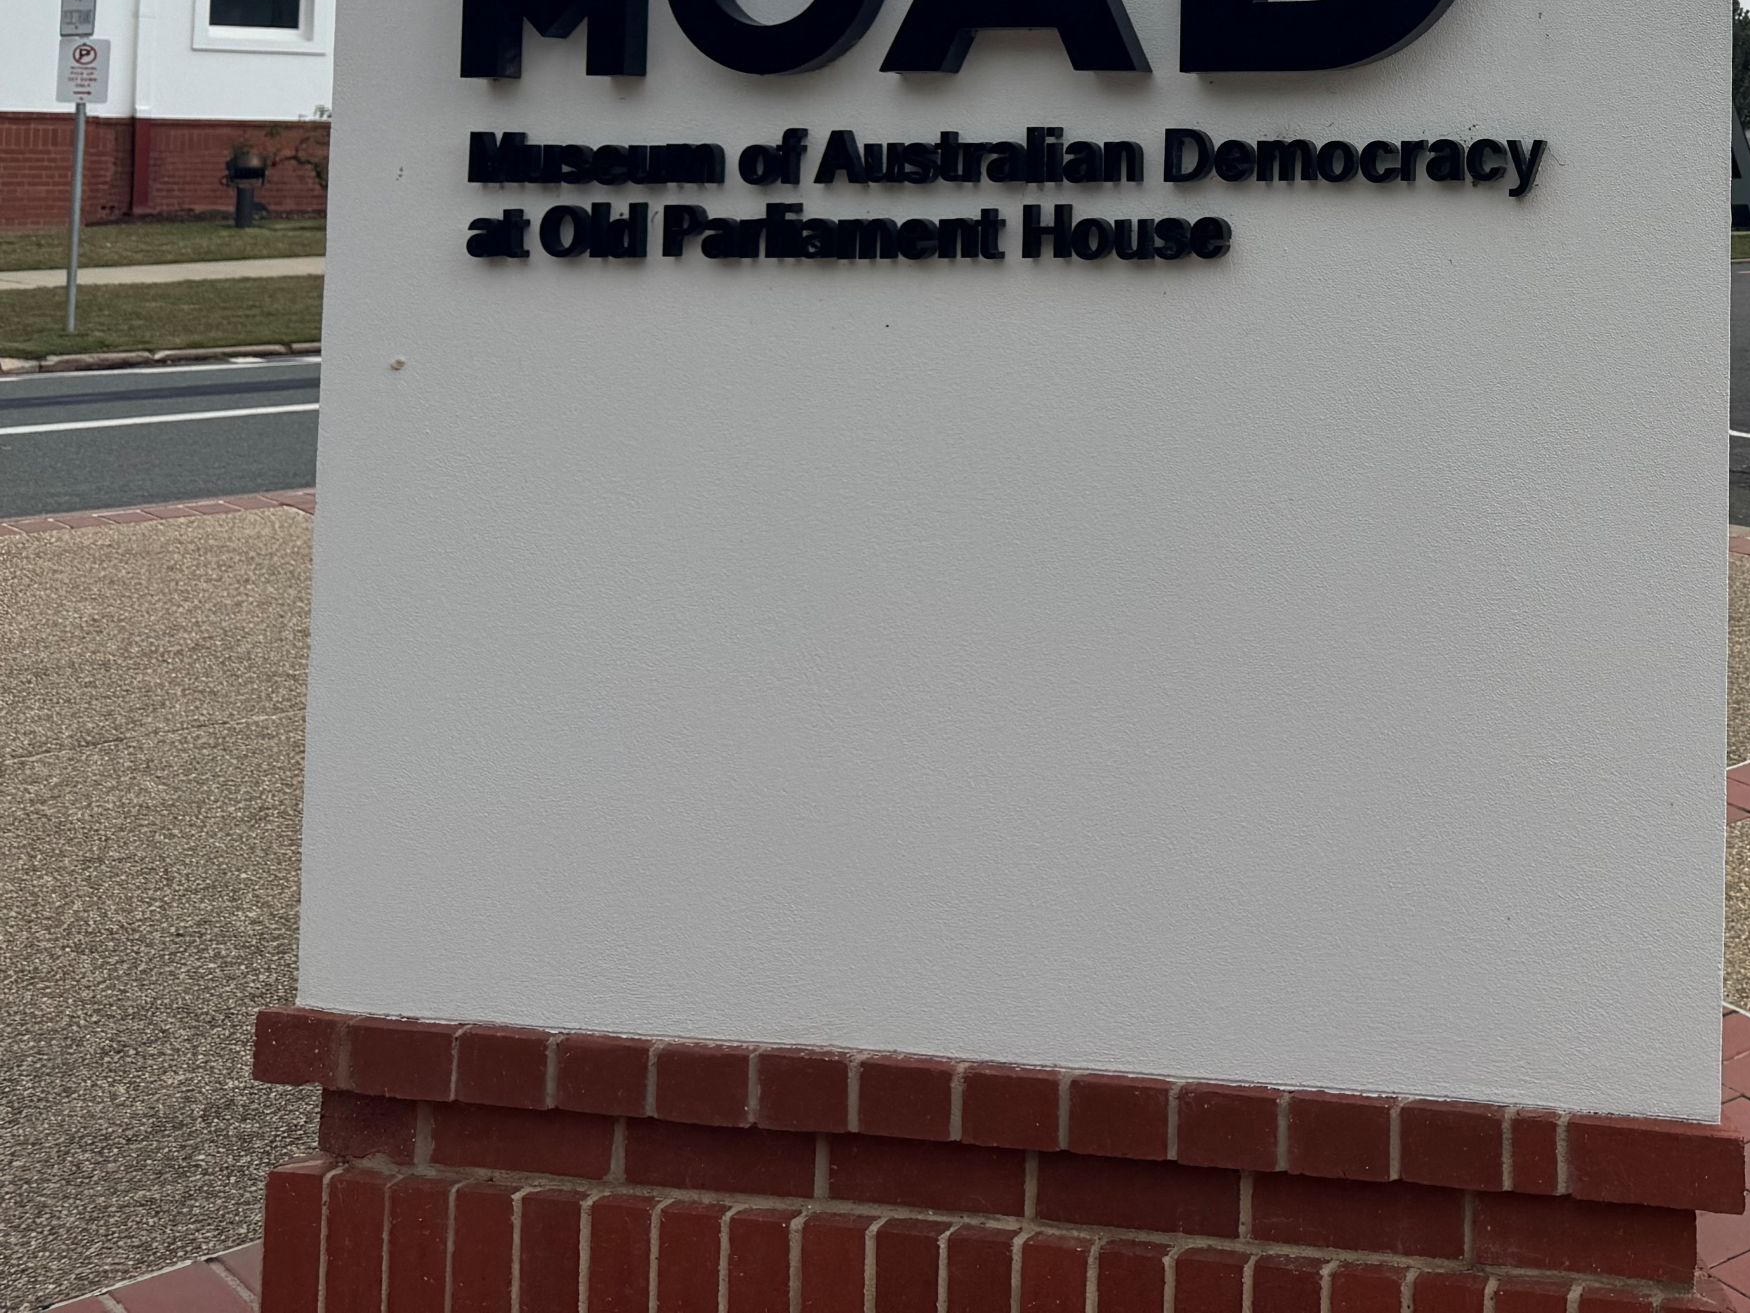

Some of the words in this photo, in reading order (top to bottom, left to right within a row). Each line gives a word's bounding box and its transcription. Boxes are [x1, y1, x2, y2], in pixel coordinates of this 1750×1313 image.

[468, 131, 726, 187] Museum
[738, 127, 809, 187] of
[814, 126, 1144, 186] Australian
[1164, 128, 1548, 199] Democracy
[466, 208, 531, 259] at
[539, 202, 649, 259] Old
[661, 202, 1006, 261] Parliament
[1021, 203, 1232, 261] House
